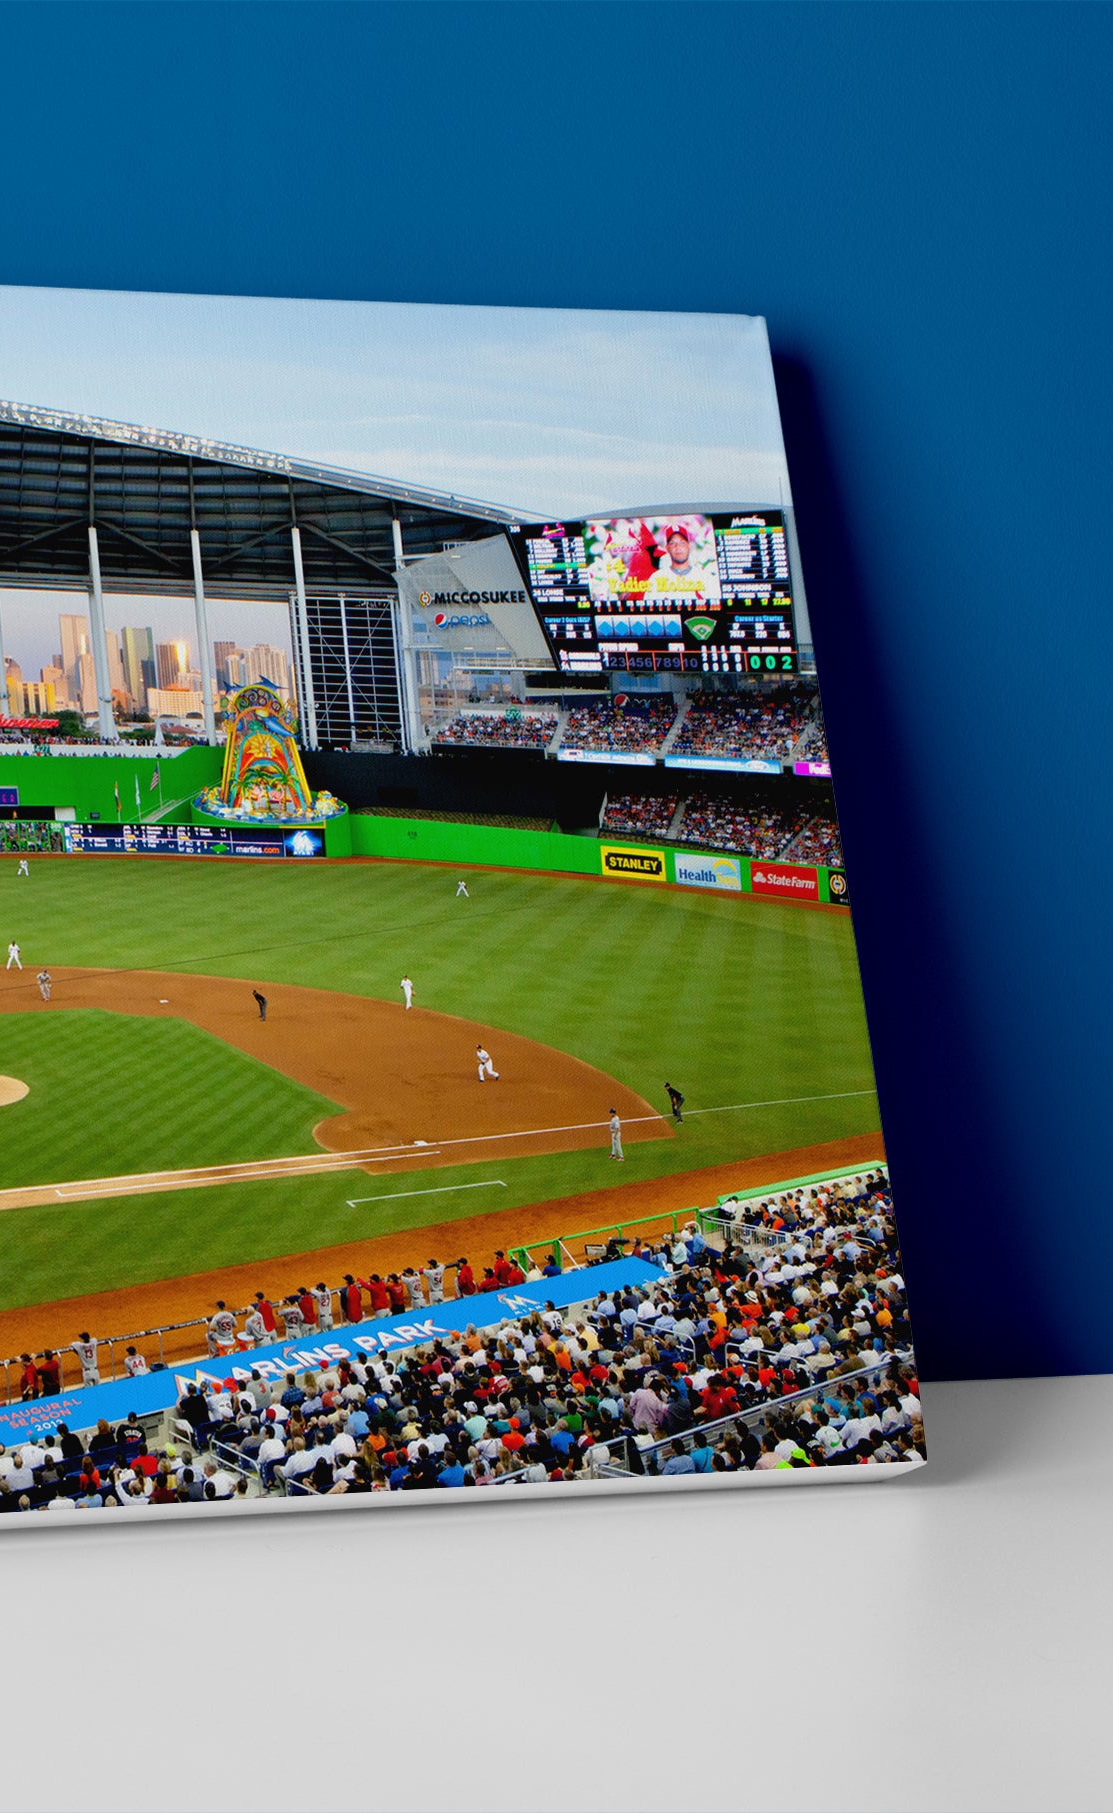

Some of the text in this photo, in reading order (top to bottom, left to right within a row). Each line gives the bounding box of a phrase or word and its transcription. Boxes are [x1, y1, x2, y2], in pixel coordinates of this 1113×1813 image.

[434, 590, 526, 604] MICCOSUKEE
[450, 612, 490, 629] pepsi
[235, 845, 280, 854] marlins.com
[609, 856, 659, 871] STANLEY
[352, 1319, 452, 1351] PARK
[9, 1408, 72, 1429] SEASON
